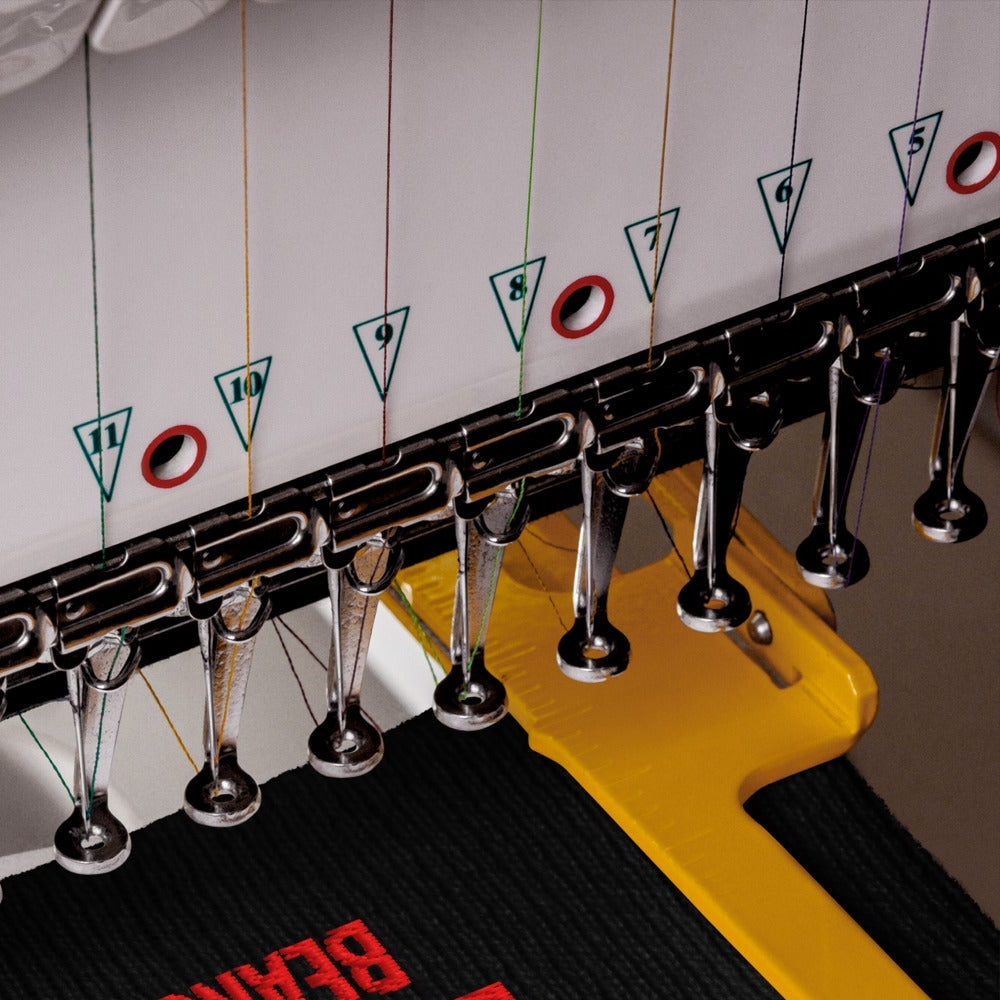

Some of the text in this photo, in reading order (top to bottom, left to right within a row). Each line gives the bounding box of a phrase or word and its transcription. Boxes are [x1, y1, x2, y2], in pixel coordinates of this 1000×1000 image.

[907, 127, 925, 155] 5
[775, 175, 793, 202] 6
[643, 223, 661, 251] 7
[508, 274, 527, 301] 8
[374, 323, 393, 351] 9
[229, 371, 263, 404] 10
[87, 423, 121, 455] 11
